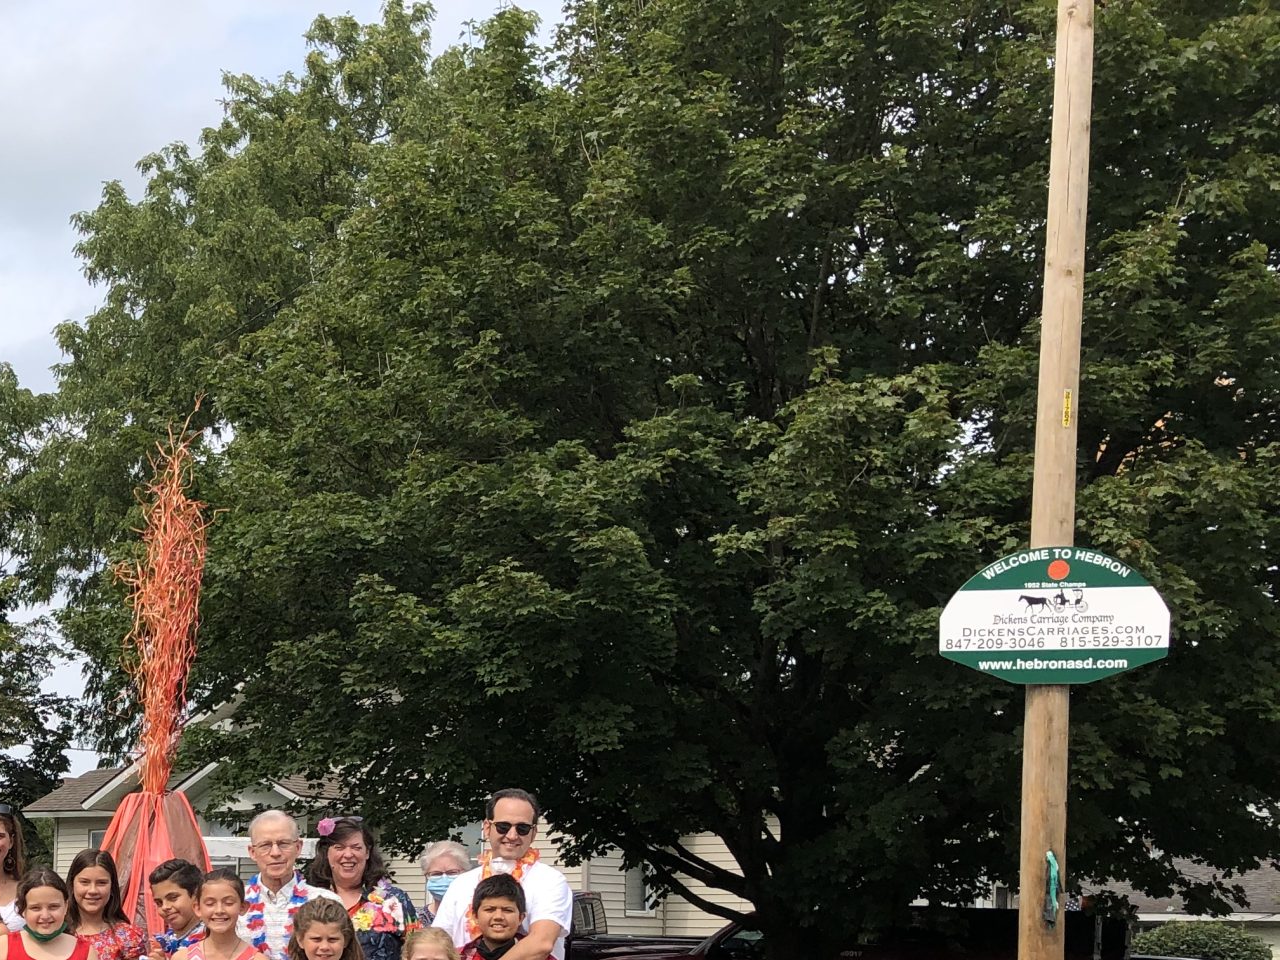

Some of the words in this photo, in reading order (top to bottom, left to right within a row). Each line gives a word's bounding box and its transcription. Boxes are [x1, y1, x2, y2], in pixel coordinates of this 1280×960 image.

[982, 550, 1049, 580] WELCOME
[1053, 549, 1072, 560] TO
[1075, 551, 1131, 578] HEBRON
[993, 614, 1028, 625] Dickens
[1030, 614, 1069, 625] Carriage
[1071, 614, 1115, 625] Company
[946, 637, 1045, 650] 847-209-3046
[1060, 635, 1162, 648] 815-529-3107
[978, 658, 1128, 670] www.hebronasd.com
